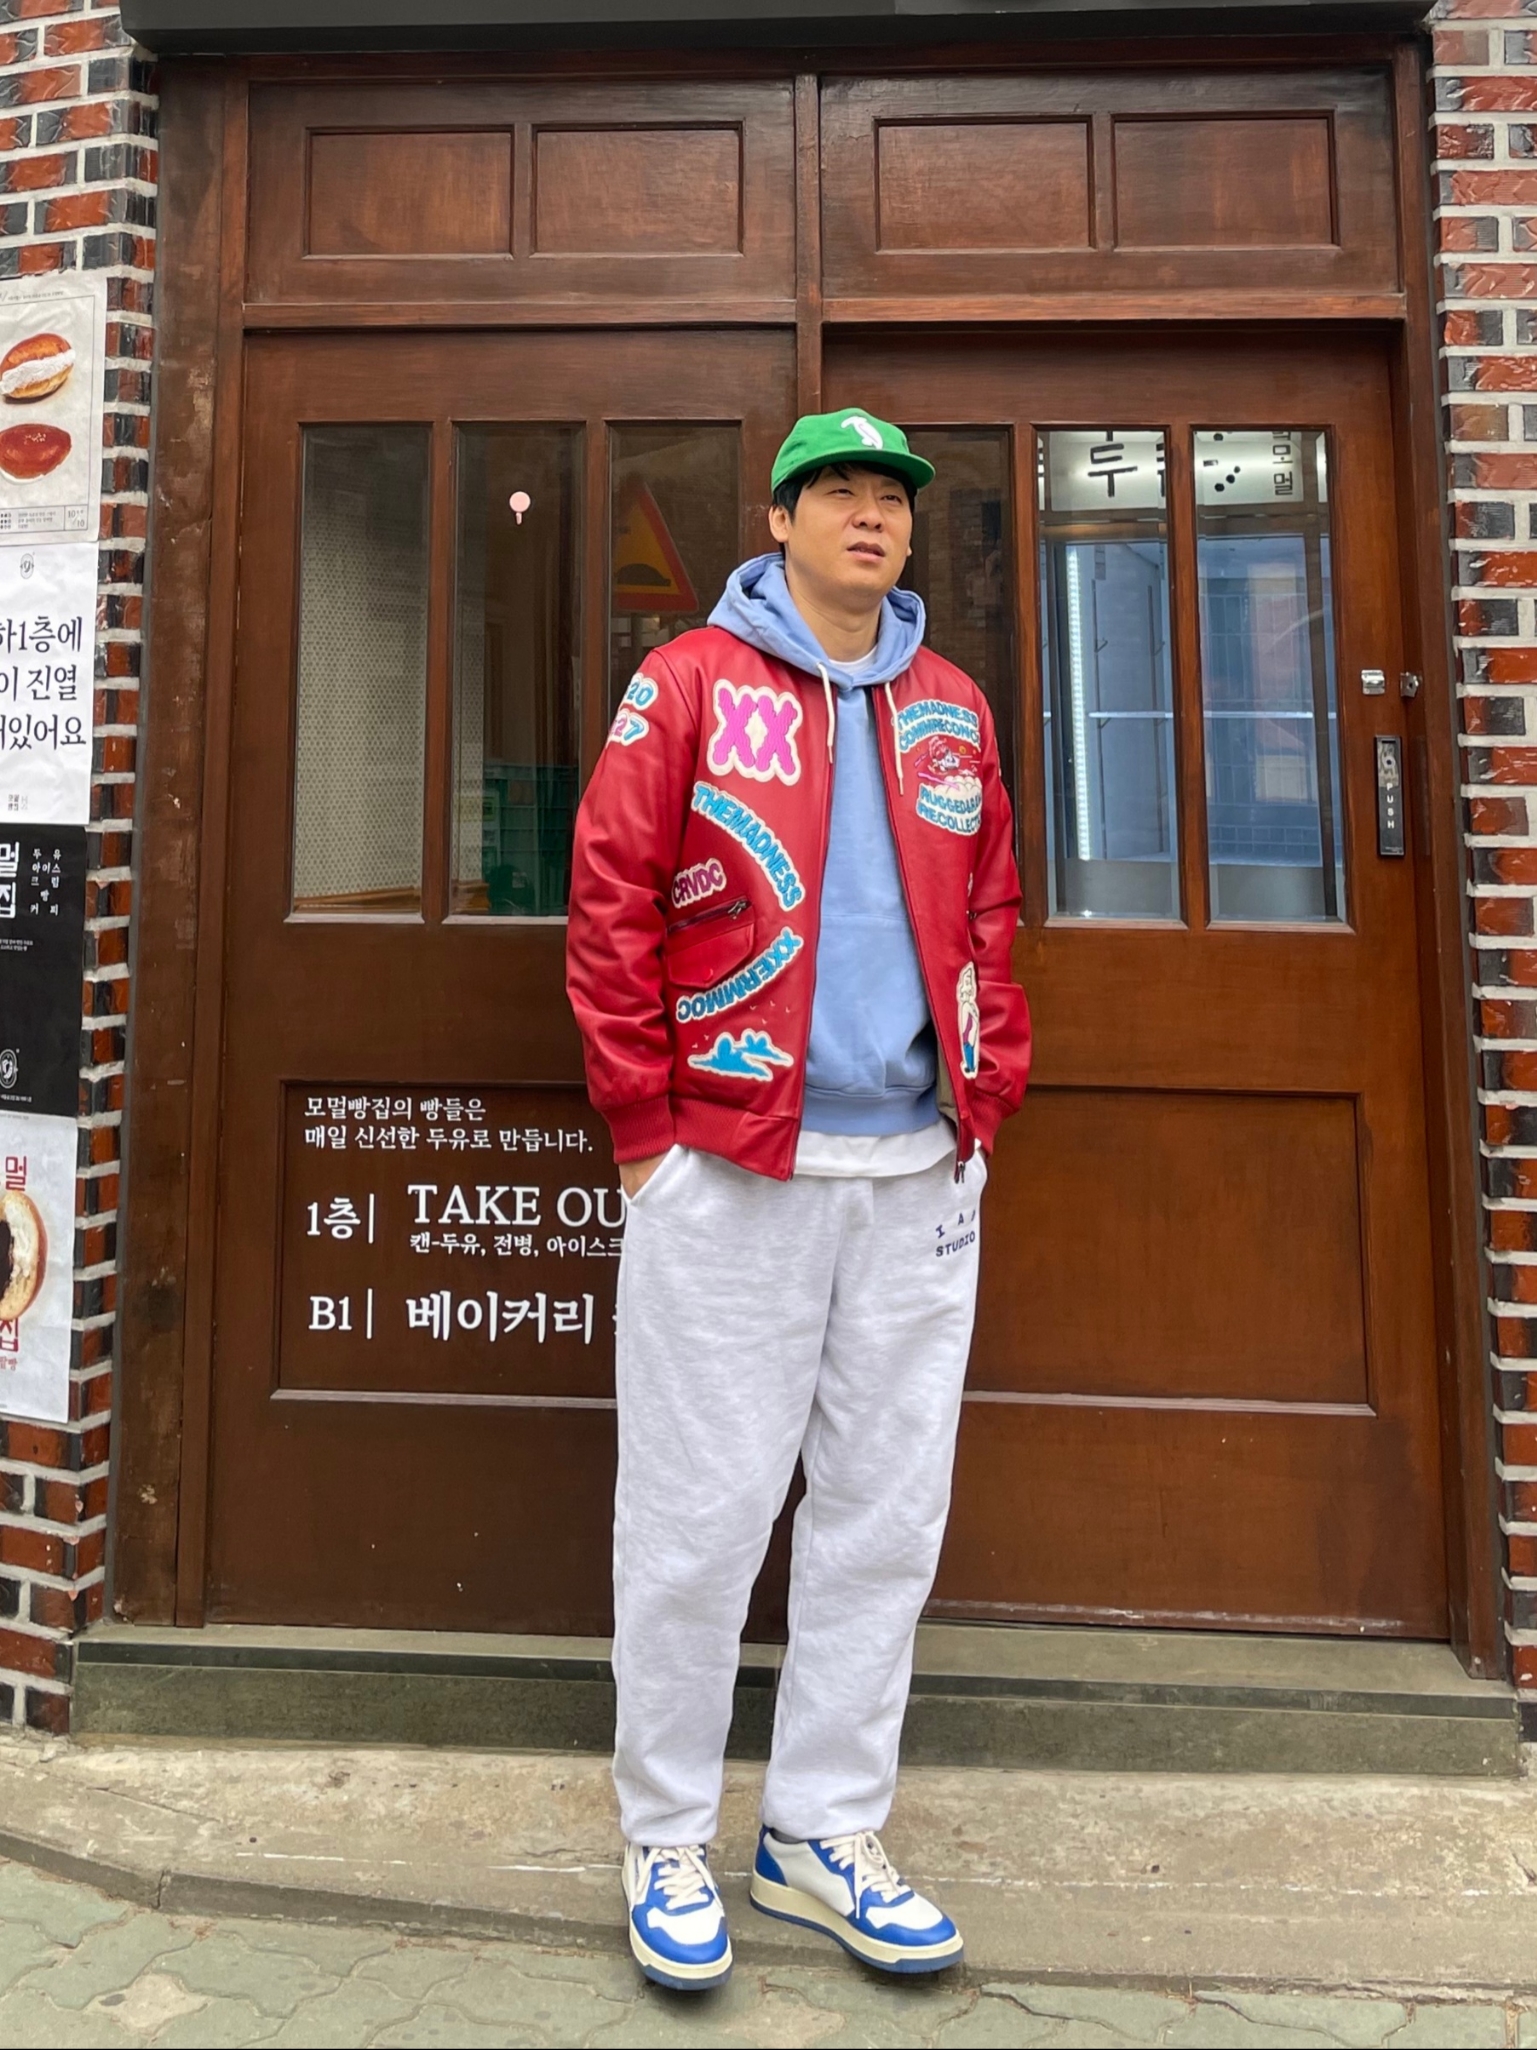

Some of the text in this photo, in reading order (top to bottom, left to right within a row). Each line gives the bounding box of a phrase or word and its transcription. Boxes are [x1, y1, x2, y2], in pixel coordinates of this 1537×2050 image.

[27, 664, 77, 701] 진열
[709, 683, 799, 780] XX
[1386, 782, 1395, 829] PUSH
[692, 782, 804, 910] THEMADNESS
[304, 1095, 486, 1122] 모멀빵집의 빵들은
[304, 1124, 593, 1154] 매일 신선한 두유로 만듭니다.
[407, 1184, 626, 1228] TAKE OU
[410, 1231, 486, 1256] 캔-두유,
[493, 1233, 539, 1257] 전병,
[935, 1230, 976, 1258] STUDIO
[308, 1296, 352, 1331] B1
[405, 1289, 594, 1345] 베이커리
